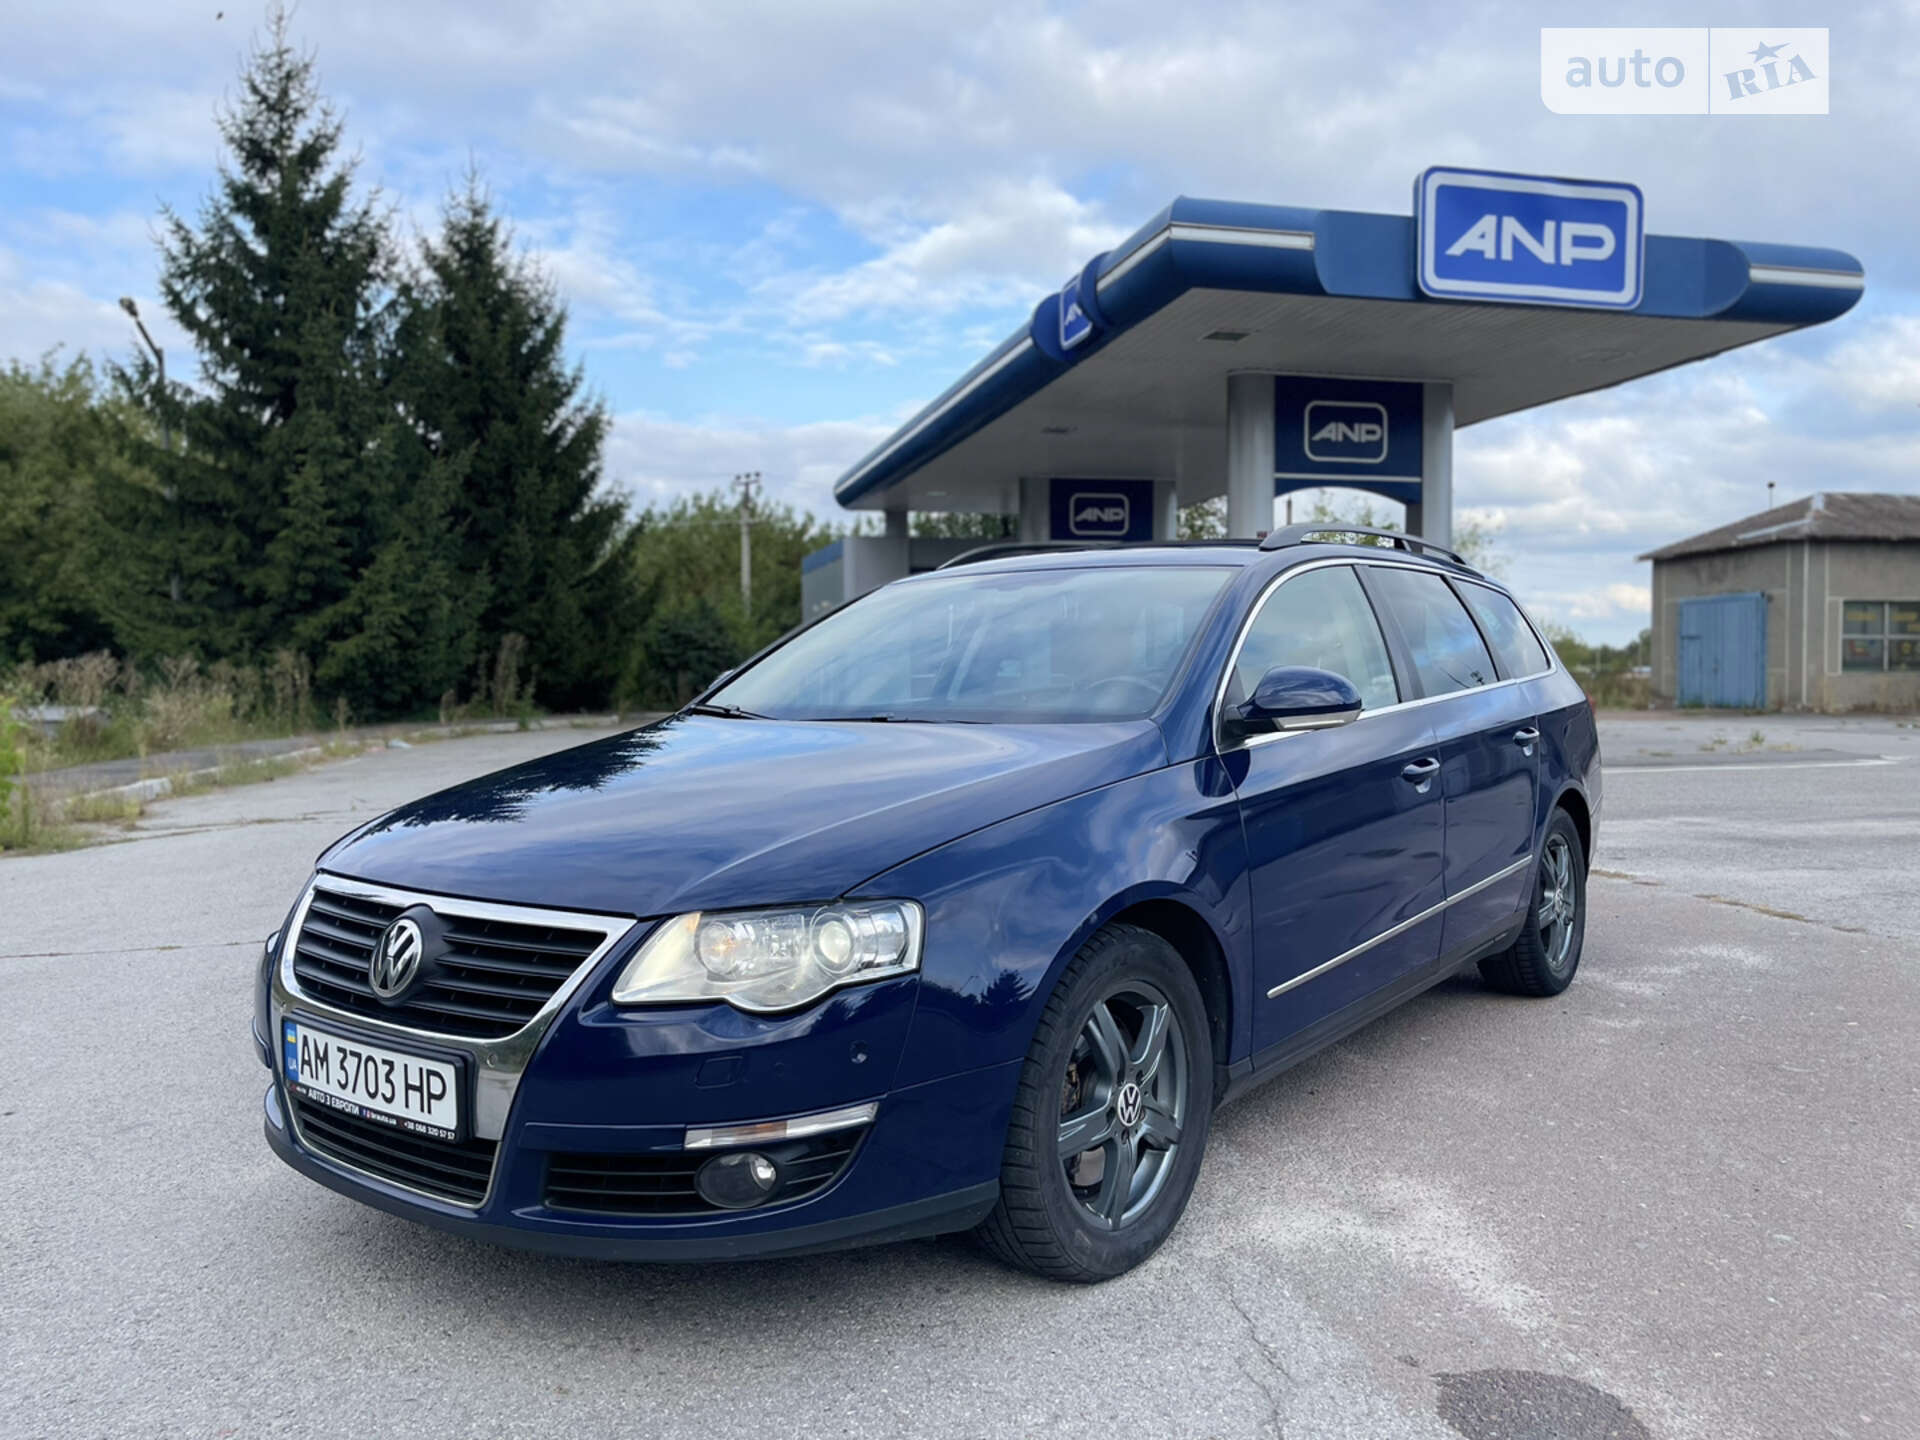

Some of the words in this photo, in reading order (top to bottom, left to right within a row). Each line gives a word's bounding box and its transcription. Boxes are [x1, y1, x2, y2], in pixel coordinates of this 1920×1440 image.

[1444, 213, 1616, 266] ANP
[1311, 421, 1383, 443] ANP
[1075, 507, 1126, 522] ANP
[300, 1034, 330, 1085] AM
[336, 1046, 396, 1104] 3703
[403, 1063, 448, 1115] HP
